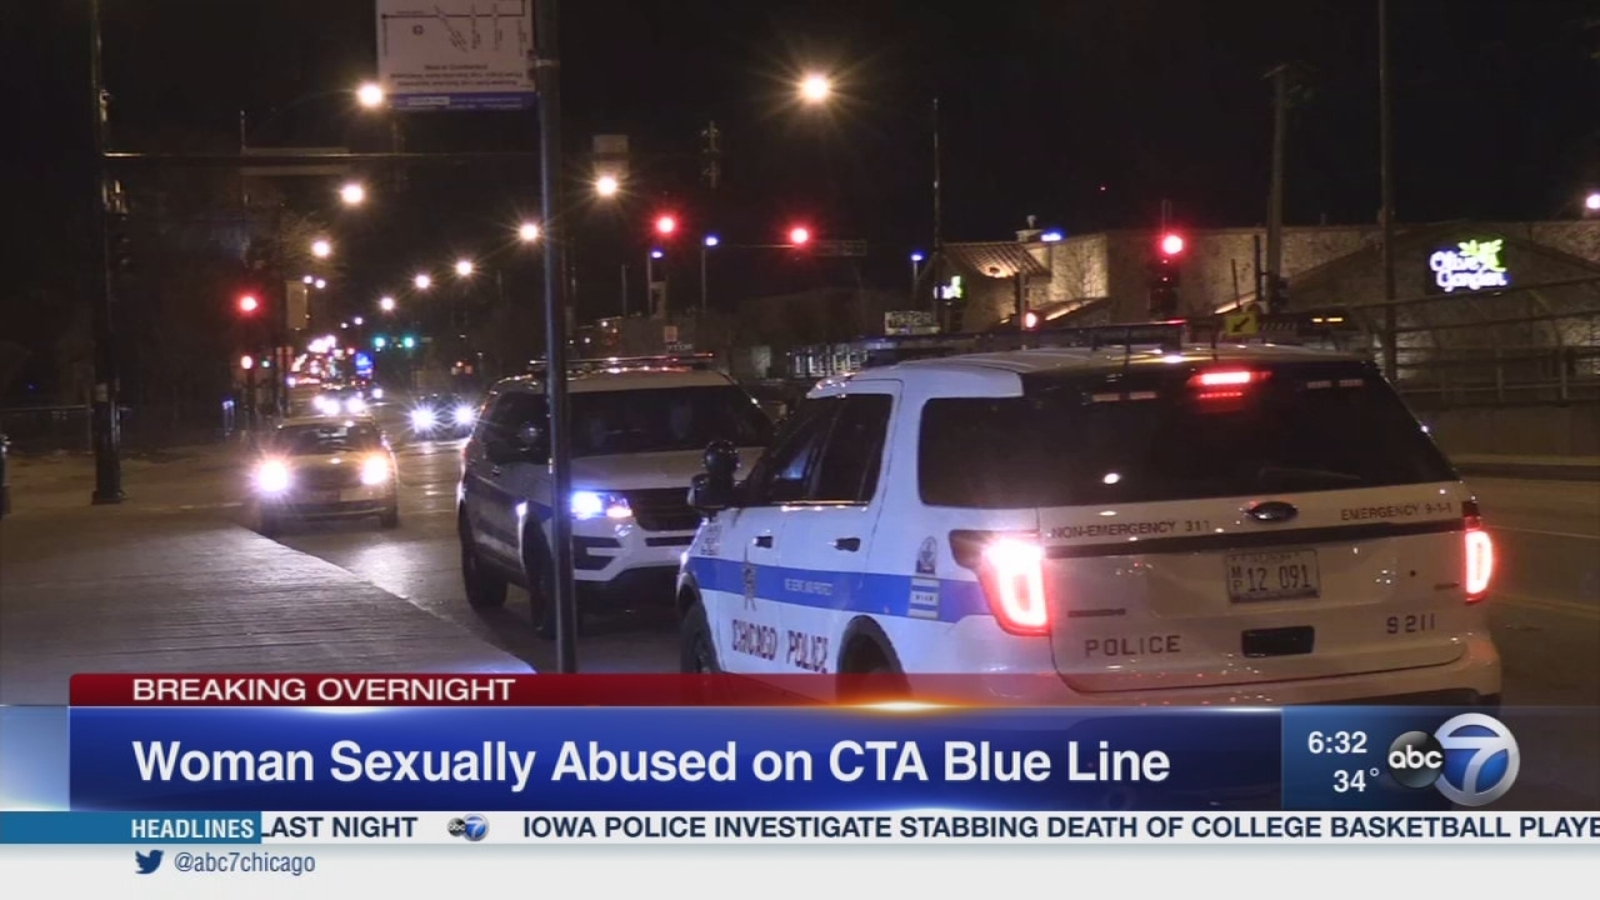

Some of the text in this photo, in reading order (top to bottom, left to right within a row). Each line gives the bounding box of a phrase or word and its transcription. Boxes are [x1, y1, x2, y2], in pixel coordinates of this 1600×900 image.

[1341, 502, 1453, 521] EMERGENCY 9-1-1
[1052, 520, 1211, 539] NON-EMERGENCY 311
[1246, 566, 1269, 593] 12
[1279, 563, 1313, 590] 091
[732, 618, 830, 674] CHICAGO POLICE
[1084, 634, 1182, 658] POLICE
